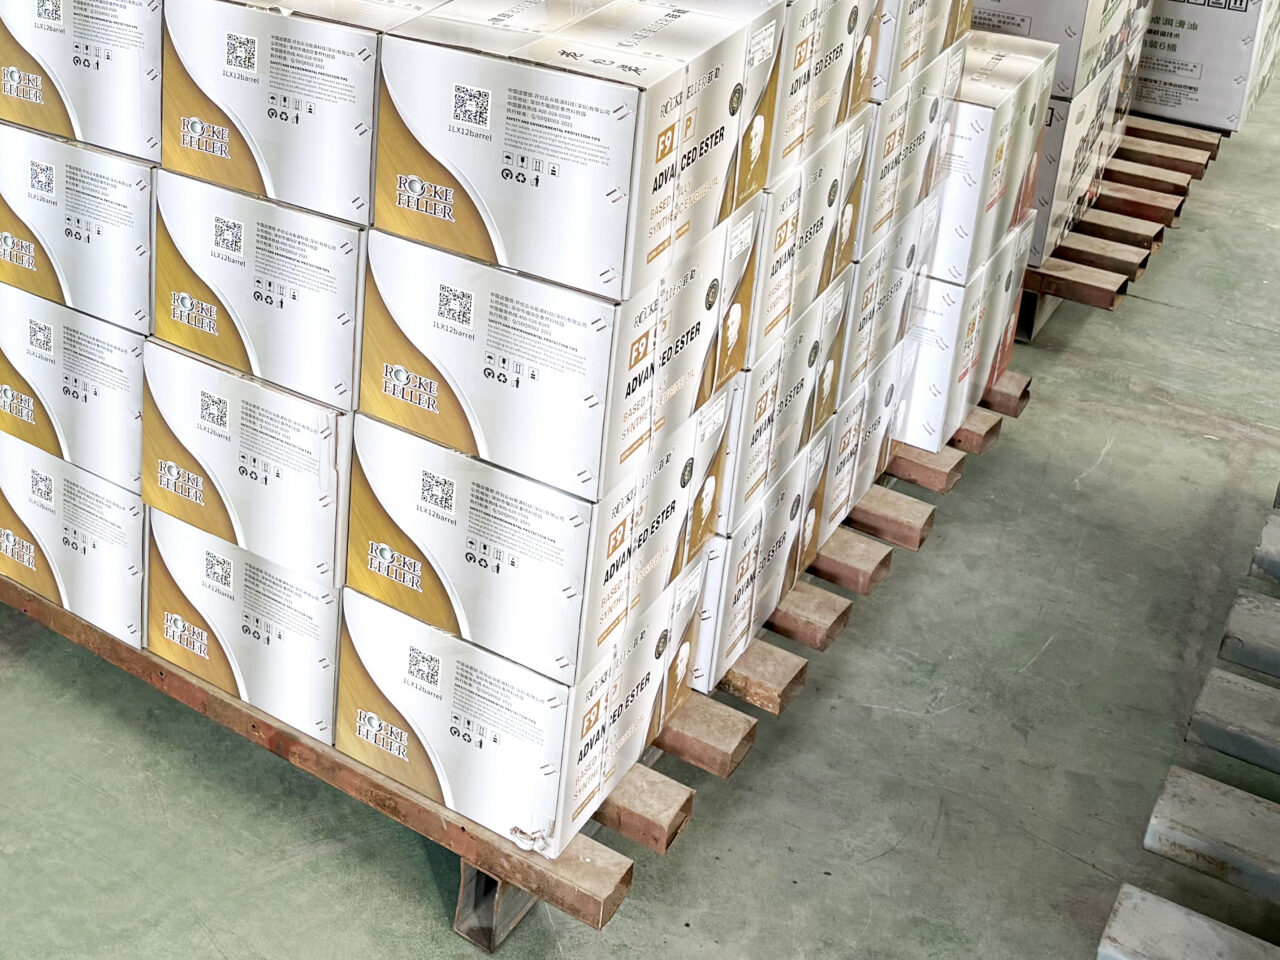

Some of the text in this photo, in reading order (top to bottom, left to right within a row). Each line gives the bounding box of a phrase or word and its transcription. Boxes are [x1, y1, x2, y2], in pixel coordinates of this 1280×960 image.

[181, 117, 229, 141] ROCKE
[698, 125, 725, 158] ESTER
[181, 134, 230, 158] FELLER
[397, 175, 454, 203] ROCKE
[396, 193, 455, 222] FELLER
[171, 306, 218, 335] FELLER
[172, 292, 217, 319] ROCKE
[674, 321, 701, 355] ESTER
[383, 364, 438, 396] ROCKE
[382, 380, 439, 414] FELLER
[158, 460, 203, 489] ROCKE
[158, 476, 204, 505] FELLER
[368, 541, 421, 575] ROCKE
[603, 500, 676, 586] ADVANED ESTER
[368, 557, 423, 592] FELLER
[625, 672, 651, 709] ESTER
[357, 709, 408, 744] ROCKE
[357, 724, 409, 761] FELLER
